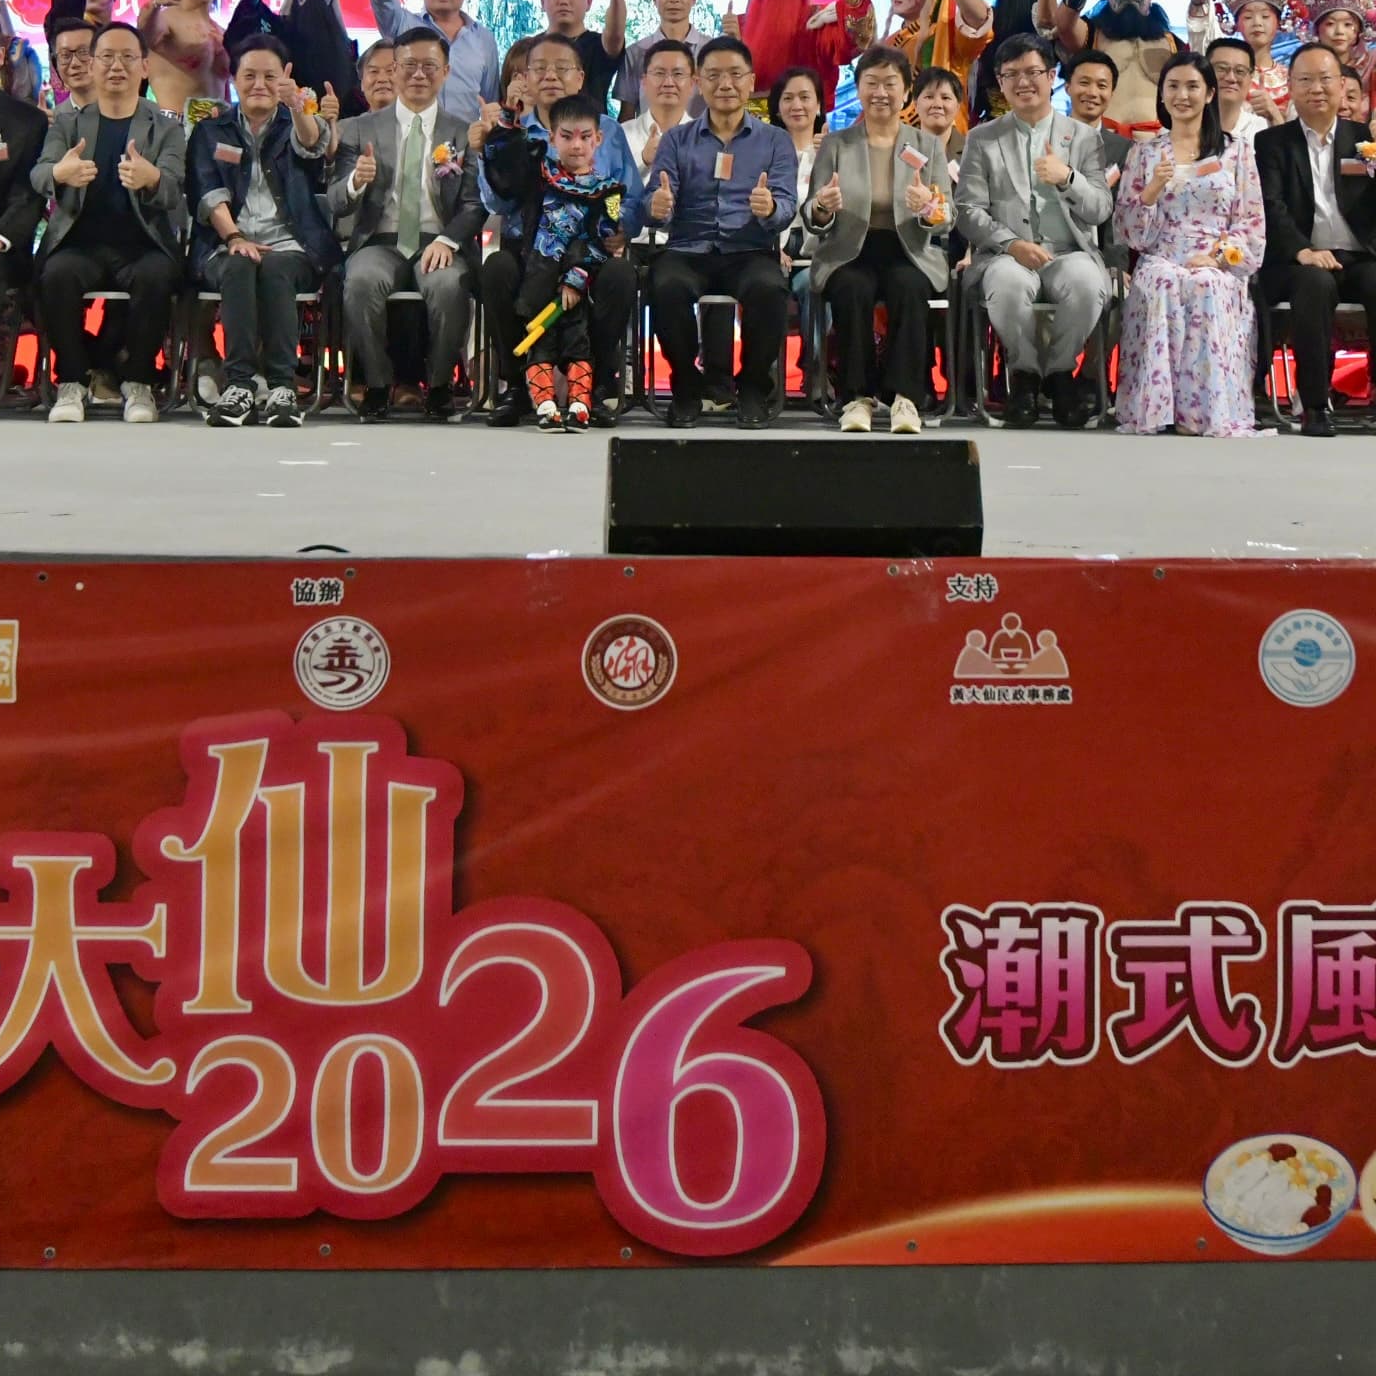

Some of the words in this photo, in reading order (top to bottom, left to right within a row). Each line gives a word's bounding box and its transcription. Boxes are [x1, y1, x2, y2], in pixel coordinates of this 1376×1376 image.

[293, 579, 342, 603] 協辦
[948, 576, 997, 599] 支持
[952, 688, 1070, 701] 黃大仙民政事務處
[183, 922, 800, 1228] 2026
